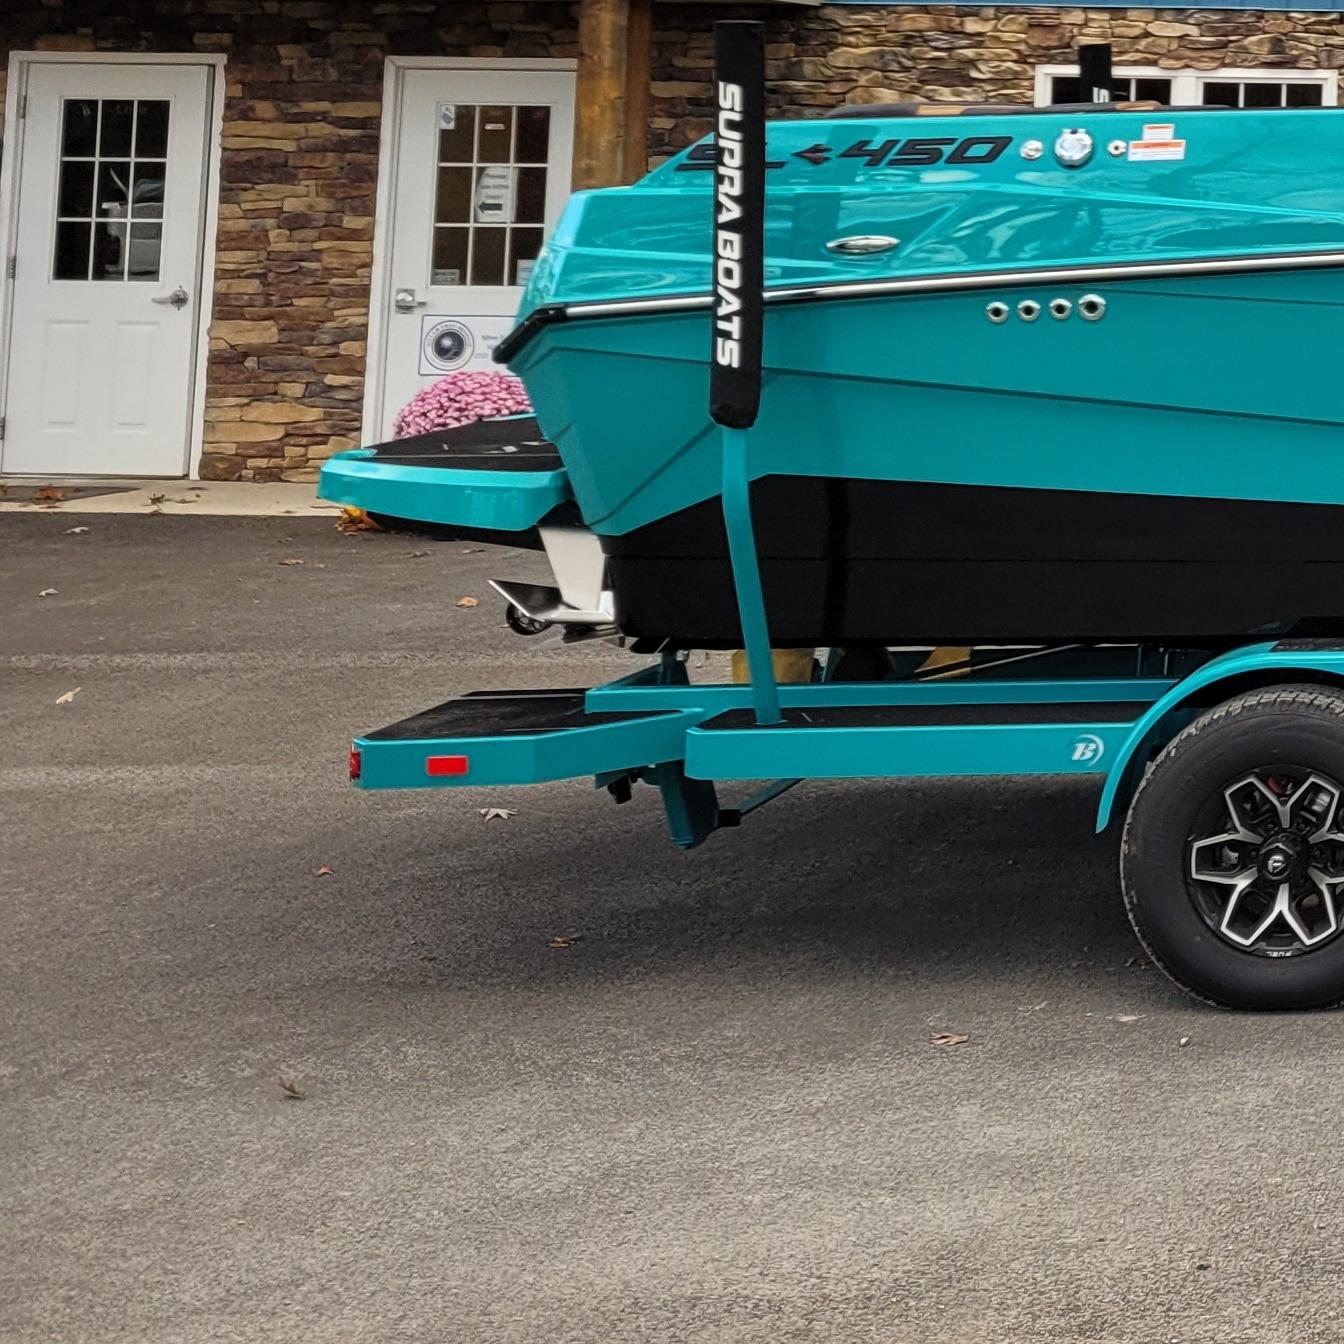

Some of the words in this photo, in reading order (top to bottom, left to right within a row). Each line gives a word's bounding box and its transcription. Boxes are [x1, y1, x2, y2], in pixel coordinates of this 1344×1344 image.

[716, 80, 745, 223] SUPRA
[834, 135, 1014, 167] 450
[714, 232, 743, 370] BOATS
